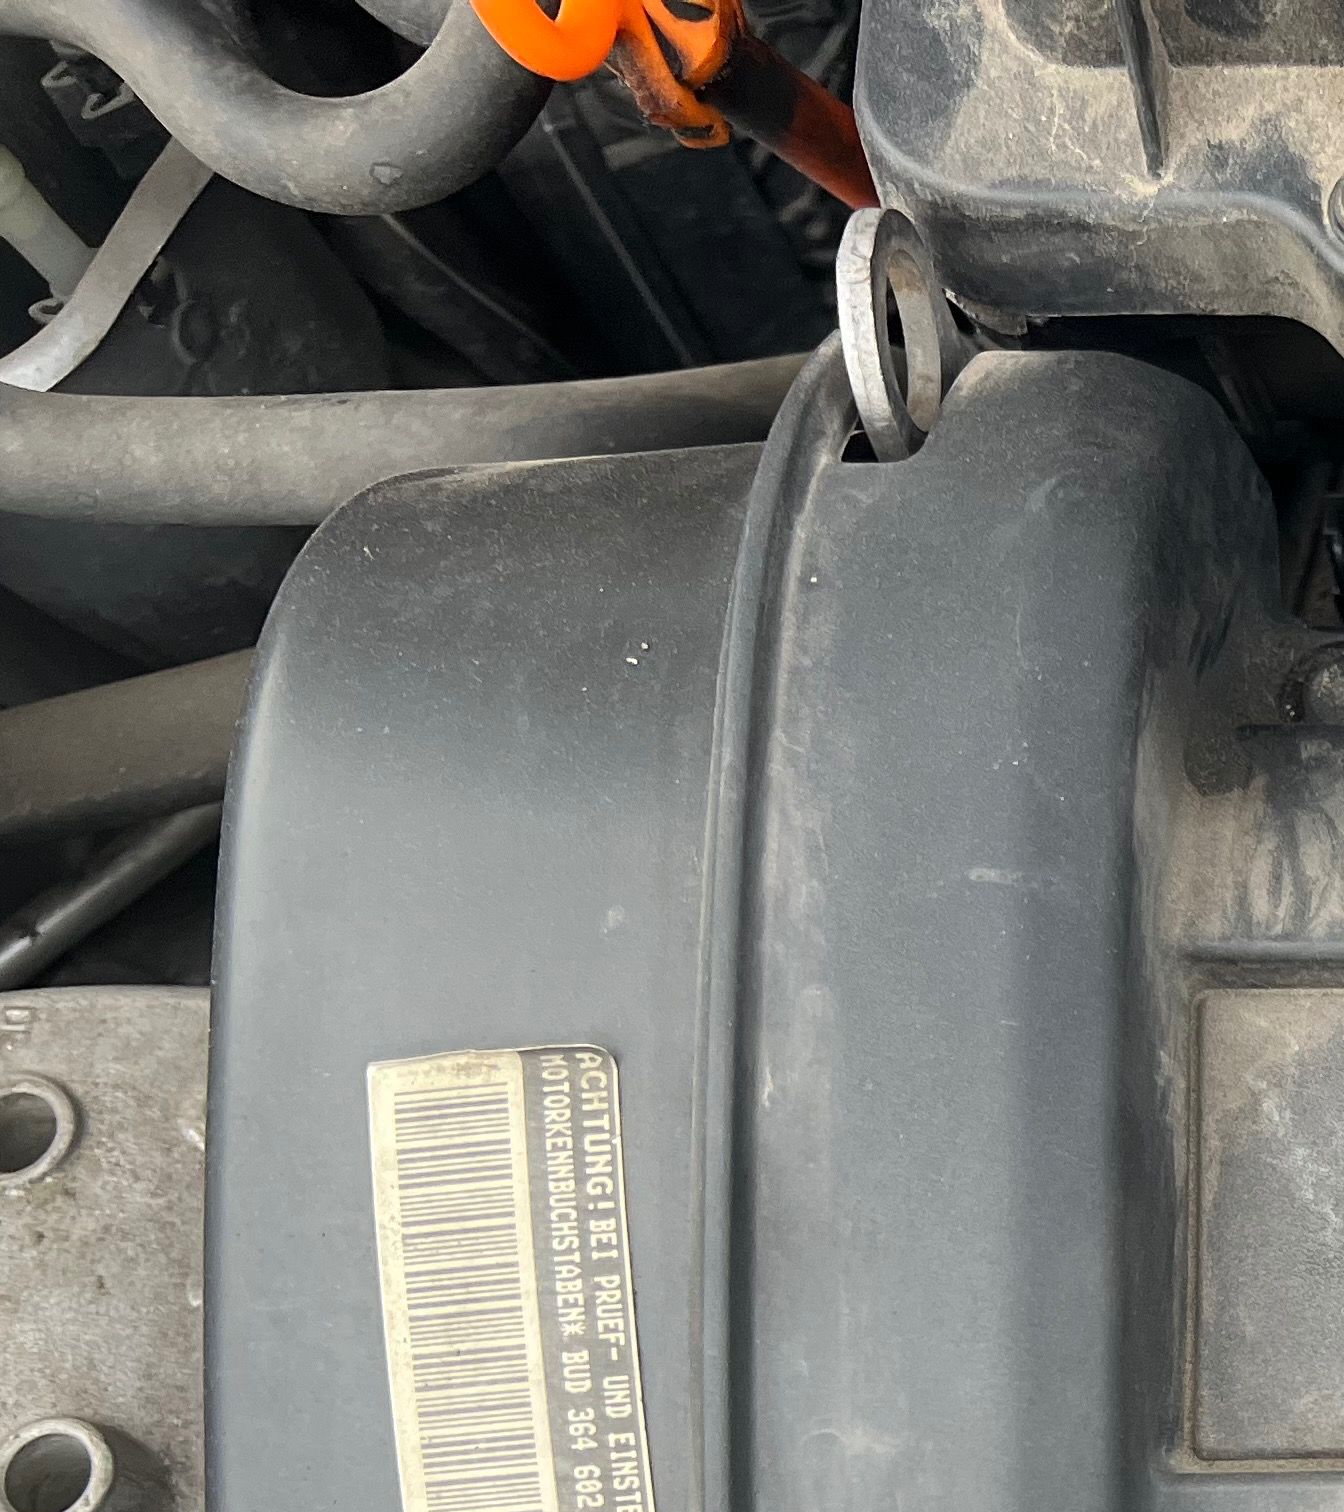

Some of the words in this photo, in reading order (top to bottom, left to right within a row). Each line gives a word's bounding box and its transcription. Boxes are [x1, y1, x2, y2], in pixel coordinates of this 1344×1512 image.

[573, 1051, 615, 1210] ACHTUNG!
[587, 1218, 618, 1261] BEI
[592, 1274, 625, 1361] PRUEF-
[560, 1350, 591, 1394] BUD
[601, 1375, 632, 1420] UND
[566, 1407, 597, 1451] 364
[572, 1464, 604, 1509] 602
